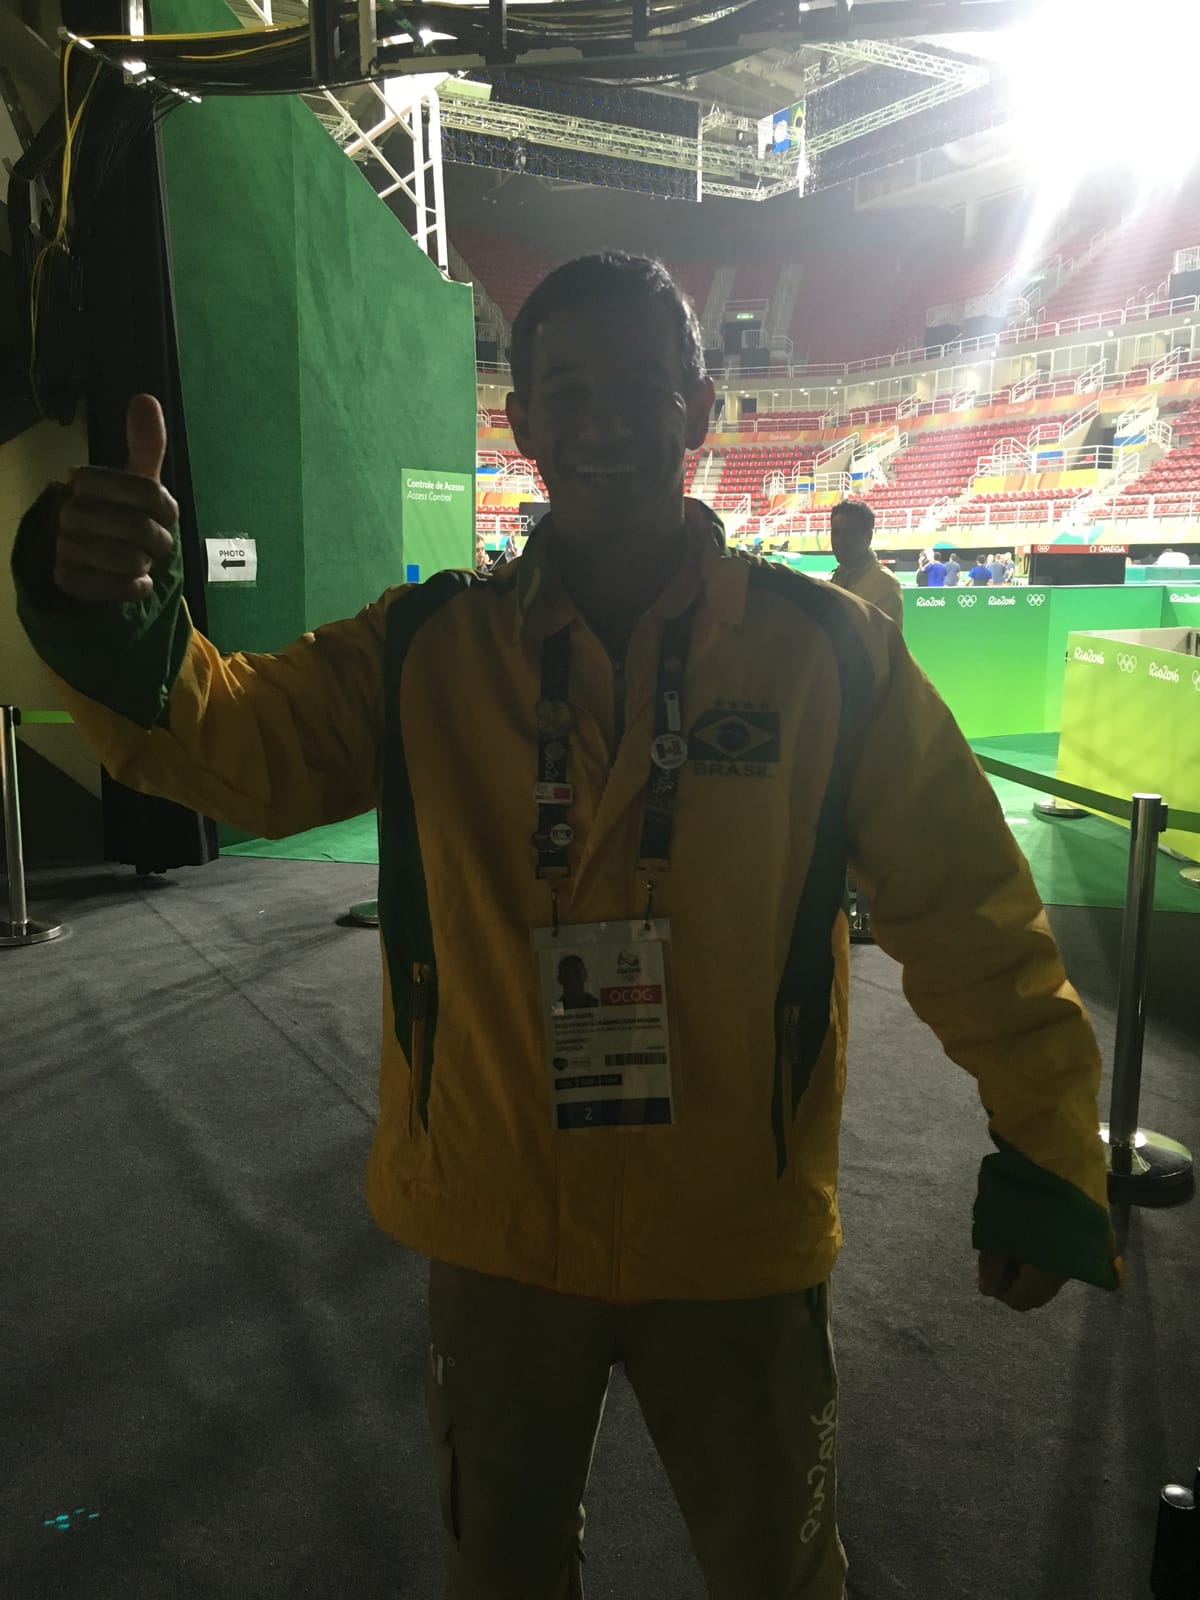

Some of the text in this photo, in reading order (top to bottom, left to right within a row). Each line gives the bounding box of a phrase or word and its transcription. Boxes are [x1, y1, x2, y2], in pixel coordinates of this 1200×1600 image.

[406, 478, 465, 492] Controle de Acesso
[407, 491, 452, 502] Access Control
[1098, 545, 1126, 553] OMEGA
[916, 596, 946, 607] Rio2016
[987, 595, 1016, 606] Rio2016
[1073, 646, 1105, 664] Rio2016
[1148, 662, 1180, 683] Rio2016
[695, 763, 776, 779] BRASIL
[609, 988, 653, 1002] OCOG
[584, 1107, 593, 1120] 2
